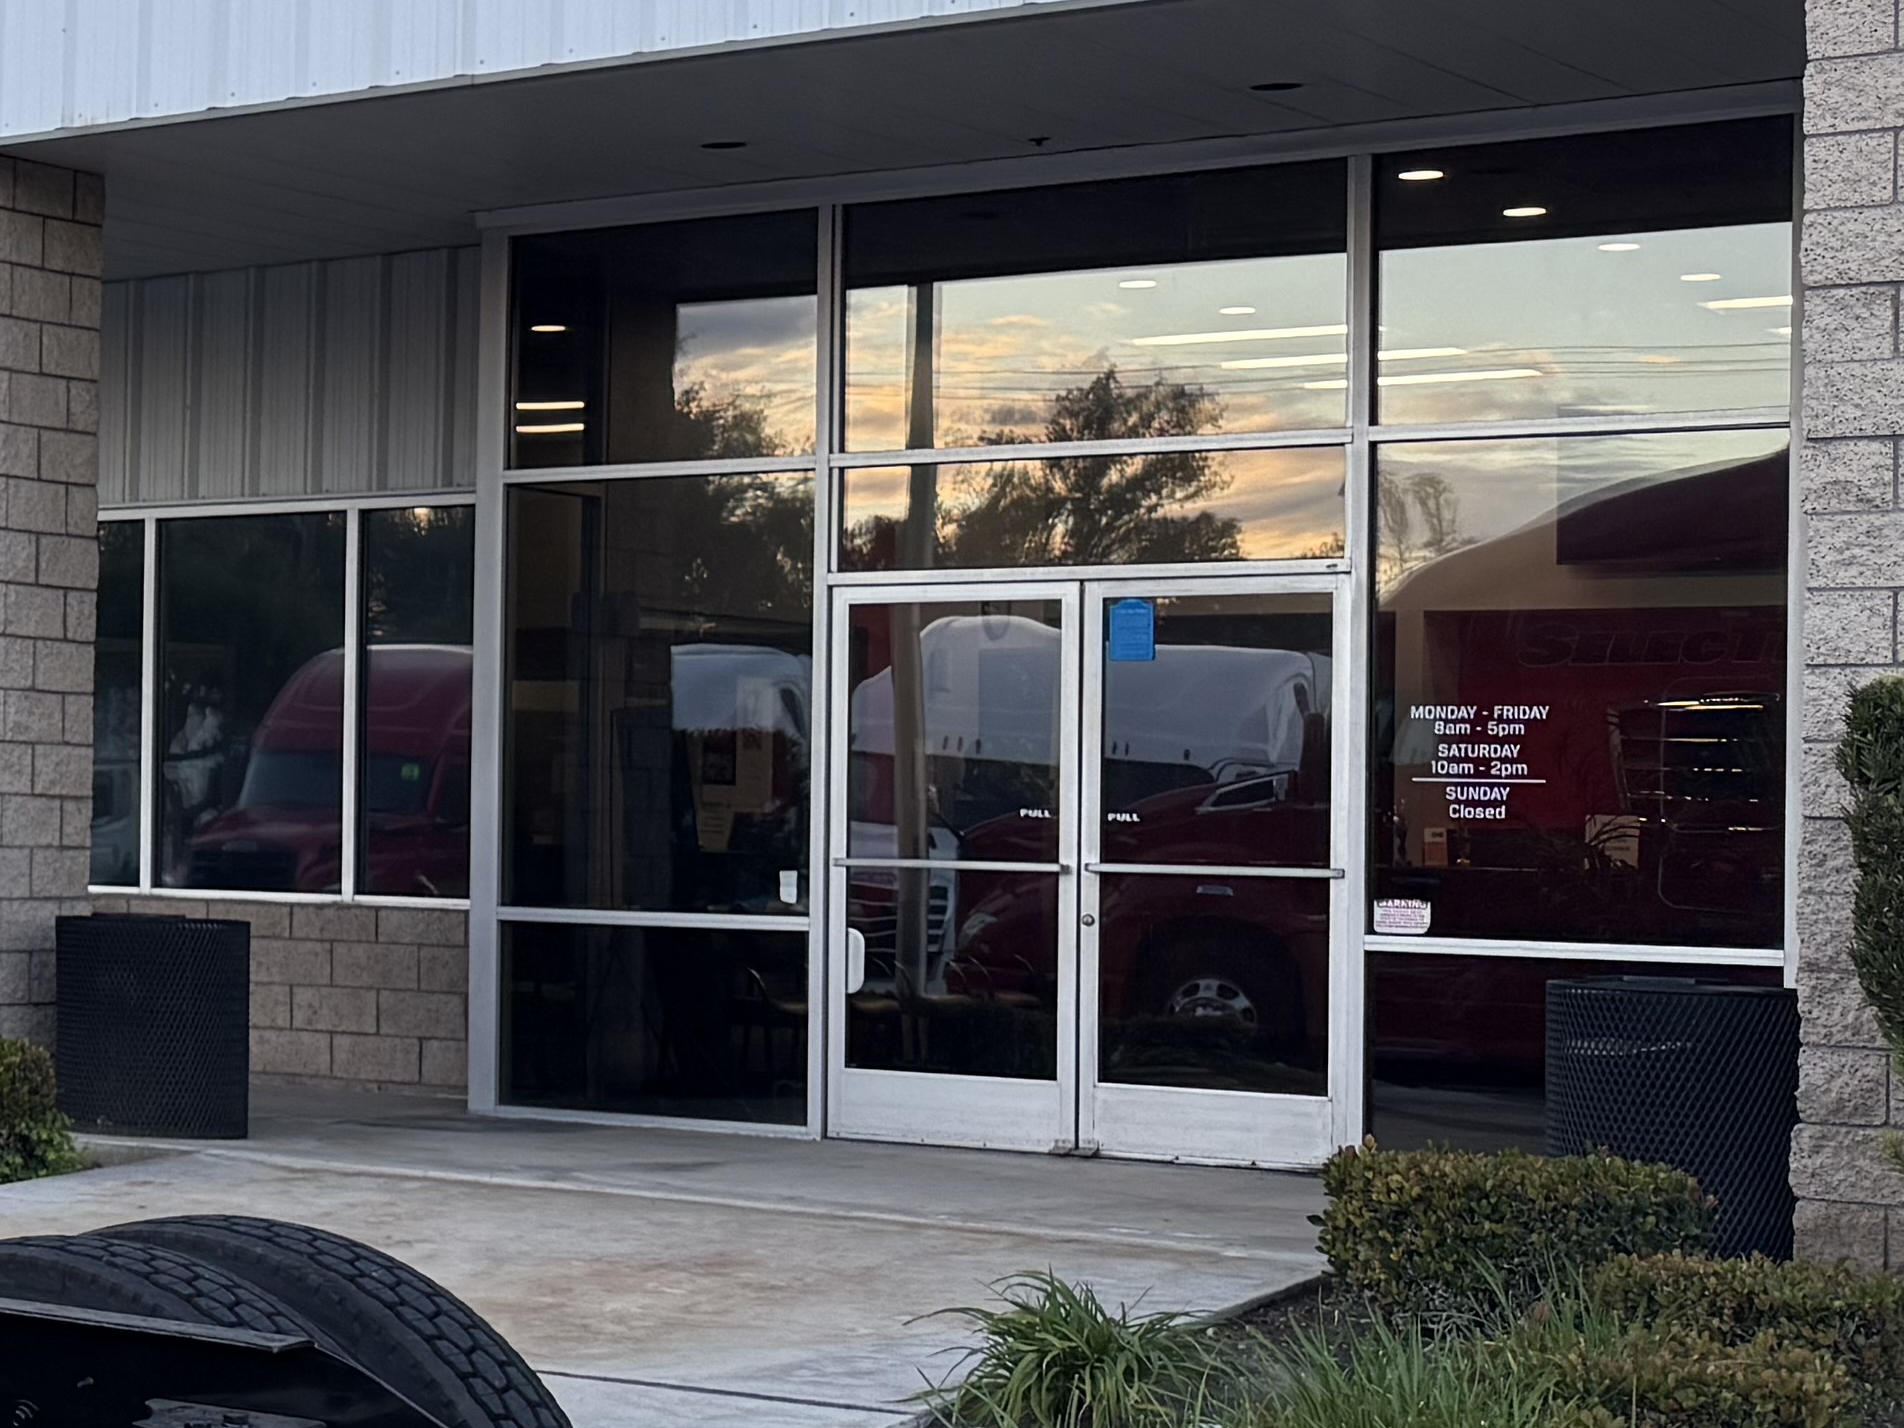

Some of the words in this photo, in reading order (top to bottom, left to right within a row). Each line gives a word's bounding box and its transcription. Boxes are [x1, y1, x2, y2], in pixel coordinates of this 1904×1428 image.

[1410, 705, 1477, 720] MONDAY
[1493, 705, 1550, 720] FRIDAY
[1434, 721, 1471, 735] 8am
[1487, 721, 1525, 737] 5pm
[1438, 744, 1521, 758] SATURDAY
[1431, 760, 1474, 775] 10am
[1490, 761, 1528, 777] 2pm
[1445, 786, 1510, 801] SUNDAY
[1019, 808, 1051, 818] PULL
[1107, 812, 1140, 822] PULL
[1449, 804, 1506, 819] Closed
